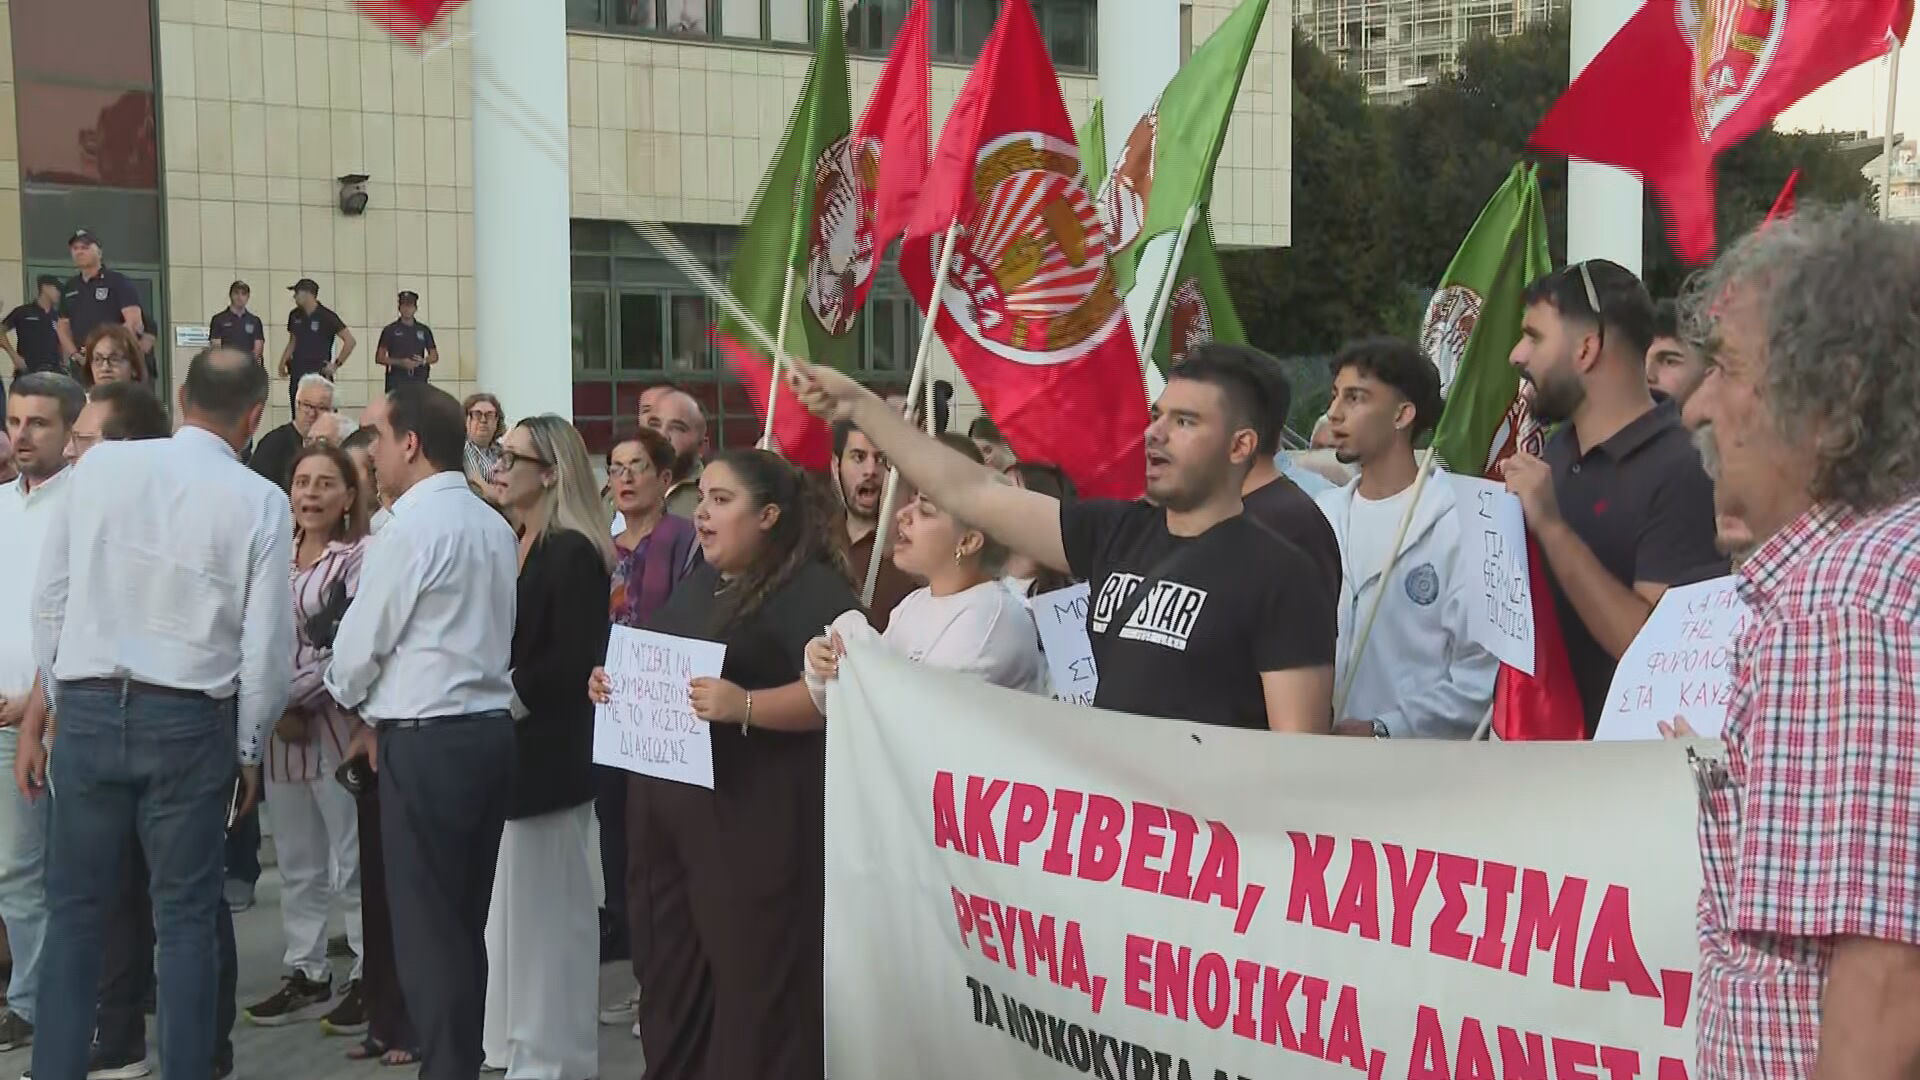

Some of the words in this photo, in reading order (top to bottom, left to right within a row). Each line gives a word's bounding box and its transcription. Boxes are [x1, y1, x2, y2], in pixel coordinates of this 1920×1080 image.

[1647, 646, 1728, 676] ΦΟΡΟΛΟ
[932, 770, 1265, 934] ΑΚΡΙΒΕΙΑ,
[1286, 831, 1694, 1029] ΚΑΥΣΙΜΑ,
[951, 886, 1107, 1013] ΡΕΥΜΑ,
[1124, 933, 1387, 1080] ΕΝΟΙΚΙΑ,
[1407, 1005, 1694, 1080] ΔΑΝ
[965, 974, 1006, 1032] ΤΑ
